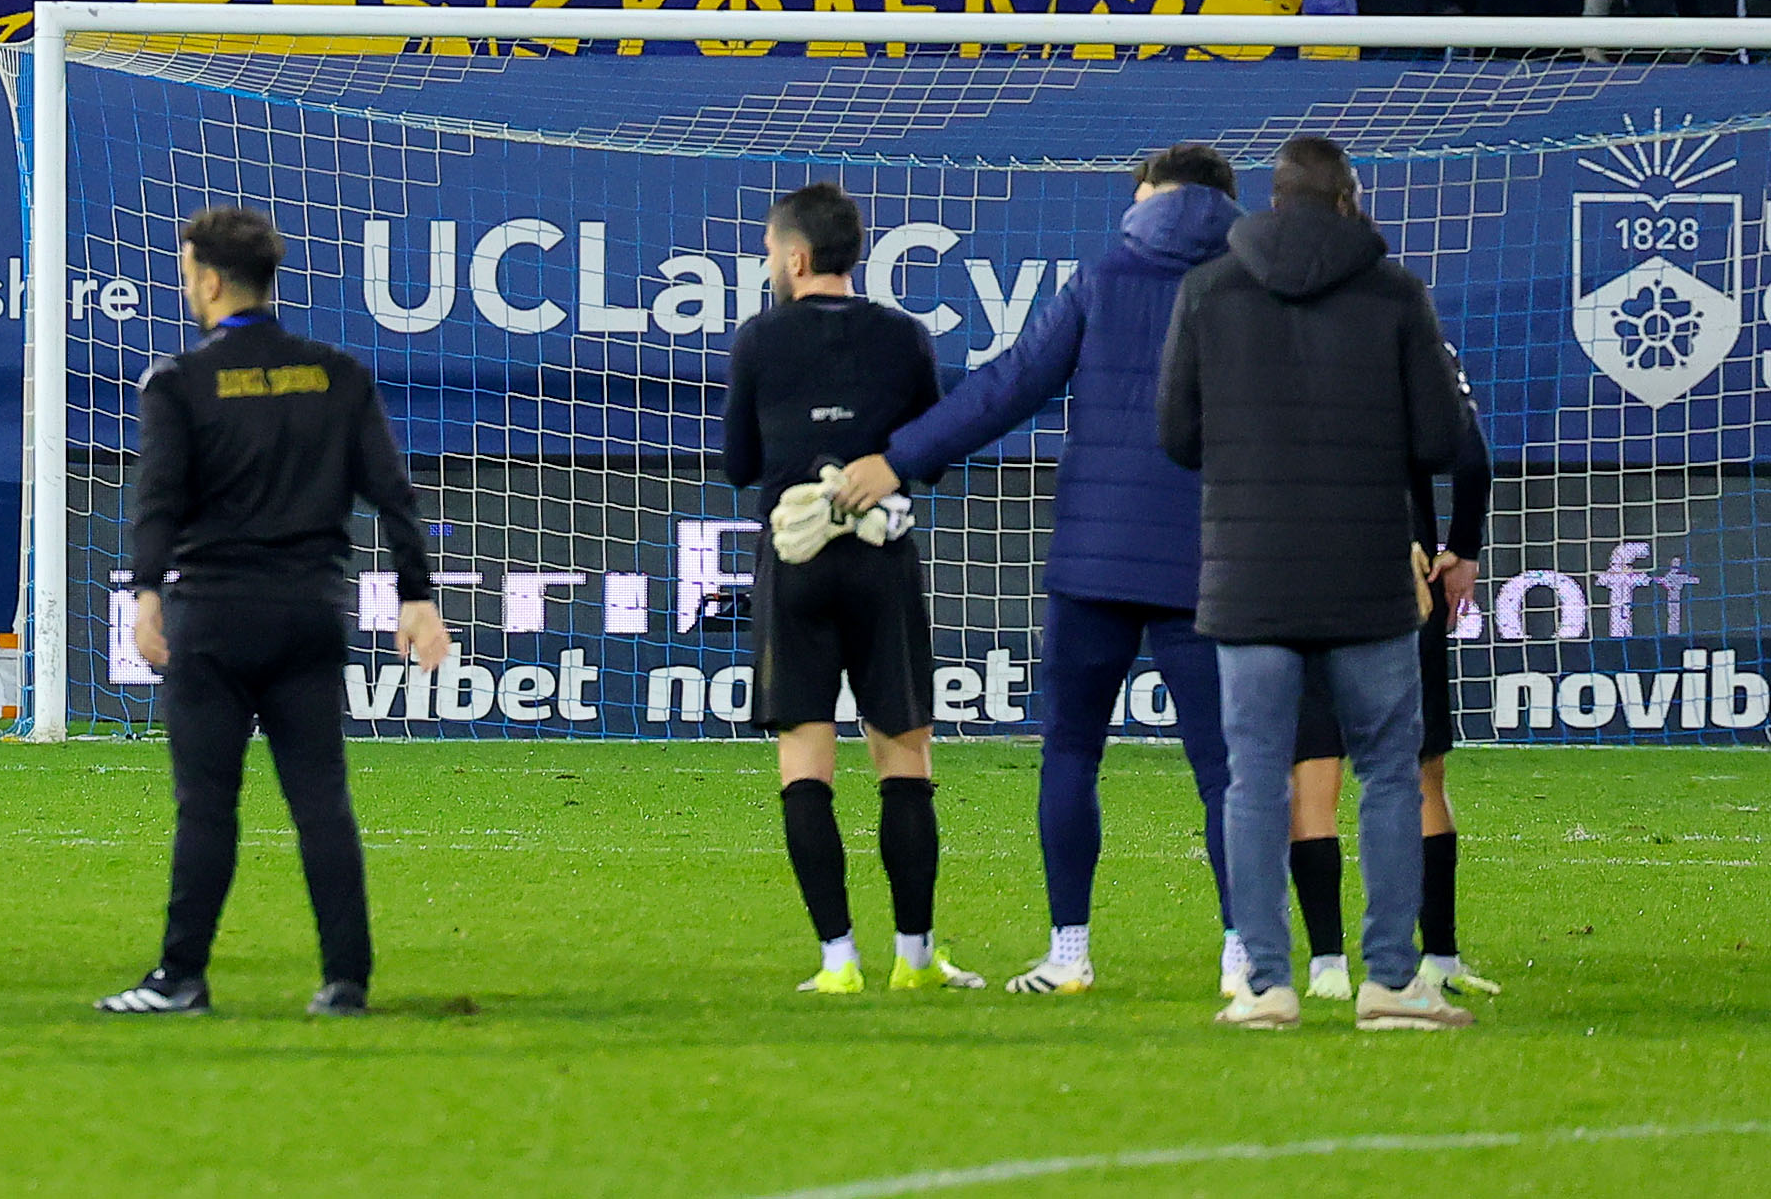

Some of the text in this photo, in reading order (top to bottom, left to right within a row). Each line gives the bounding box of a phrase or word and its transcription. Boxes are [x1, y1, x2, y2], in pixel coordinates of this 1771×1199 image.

[1614, 217, 1699, 252] 1828
[865, 222, 1078, 370] Cy
[344, 643, 598, 722] vibet
